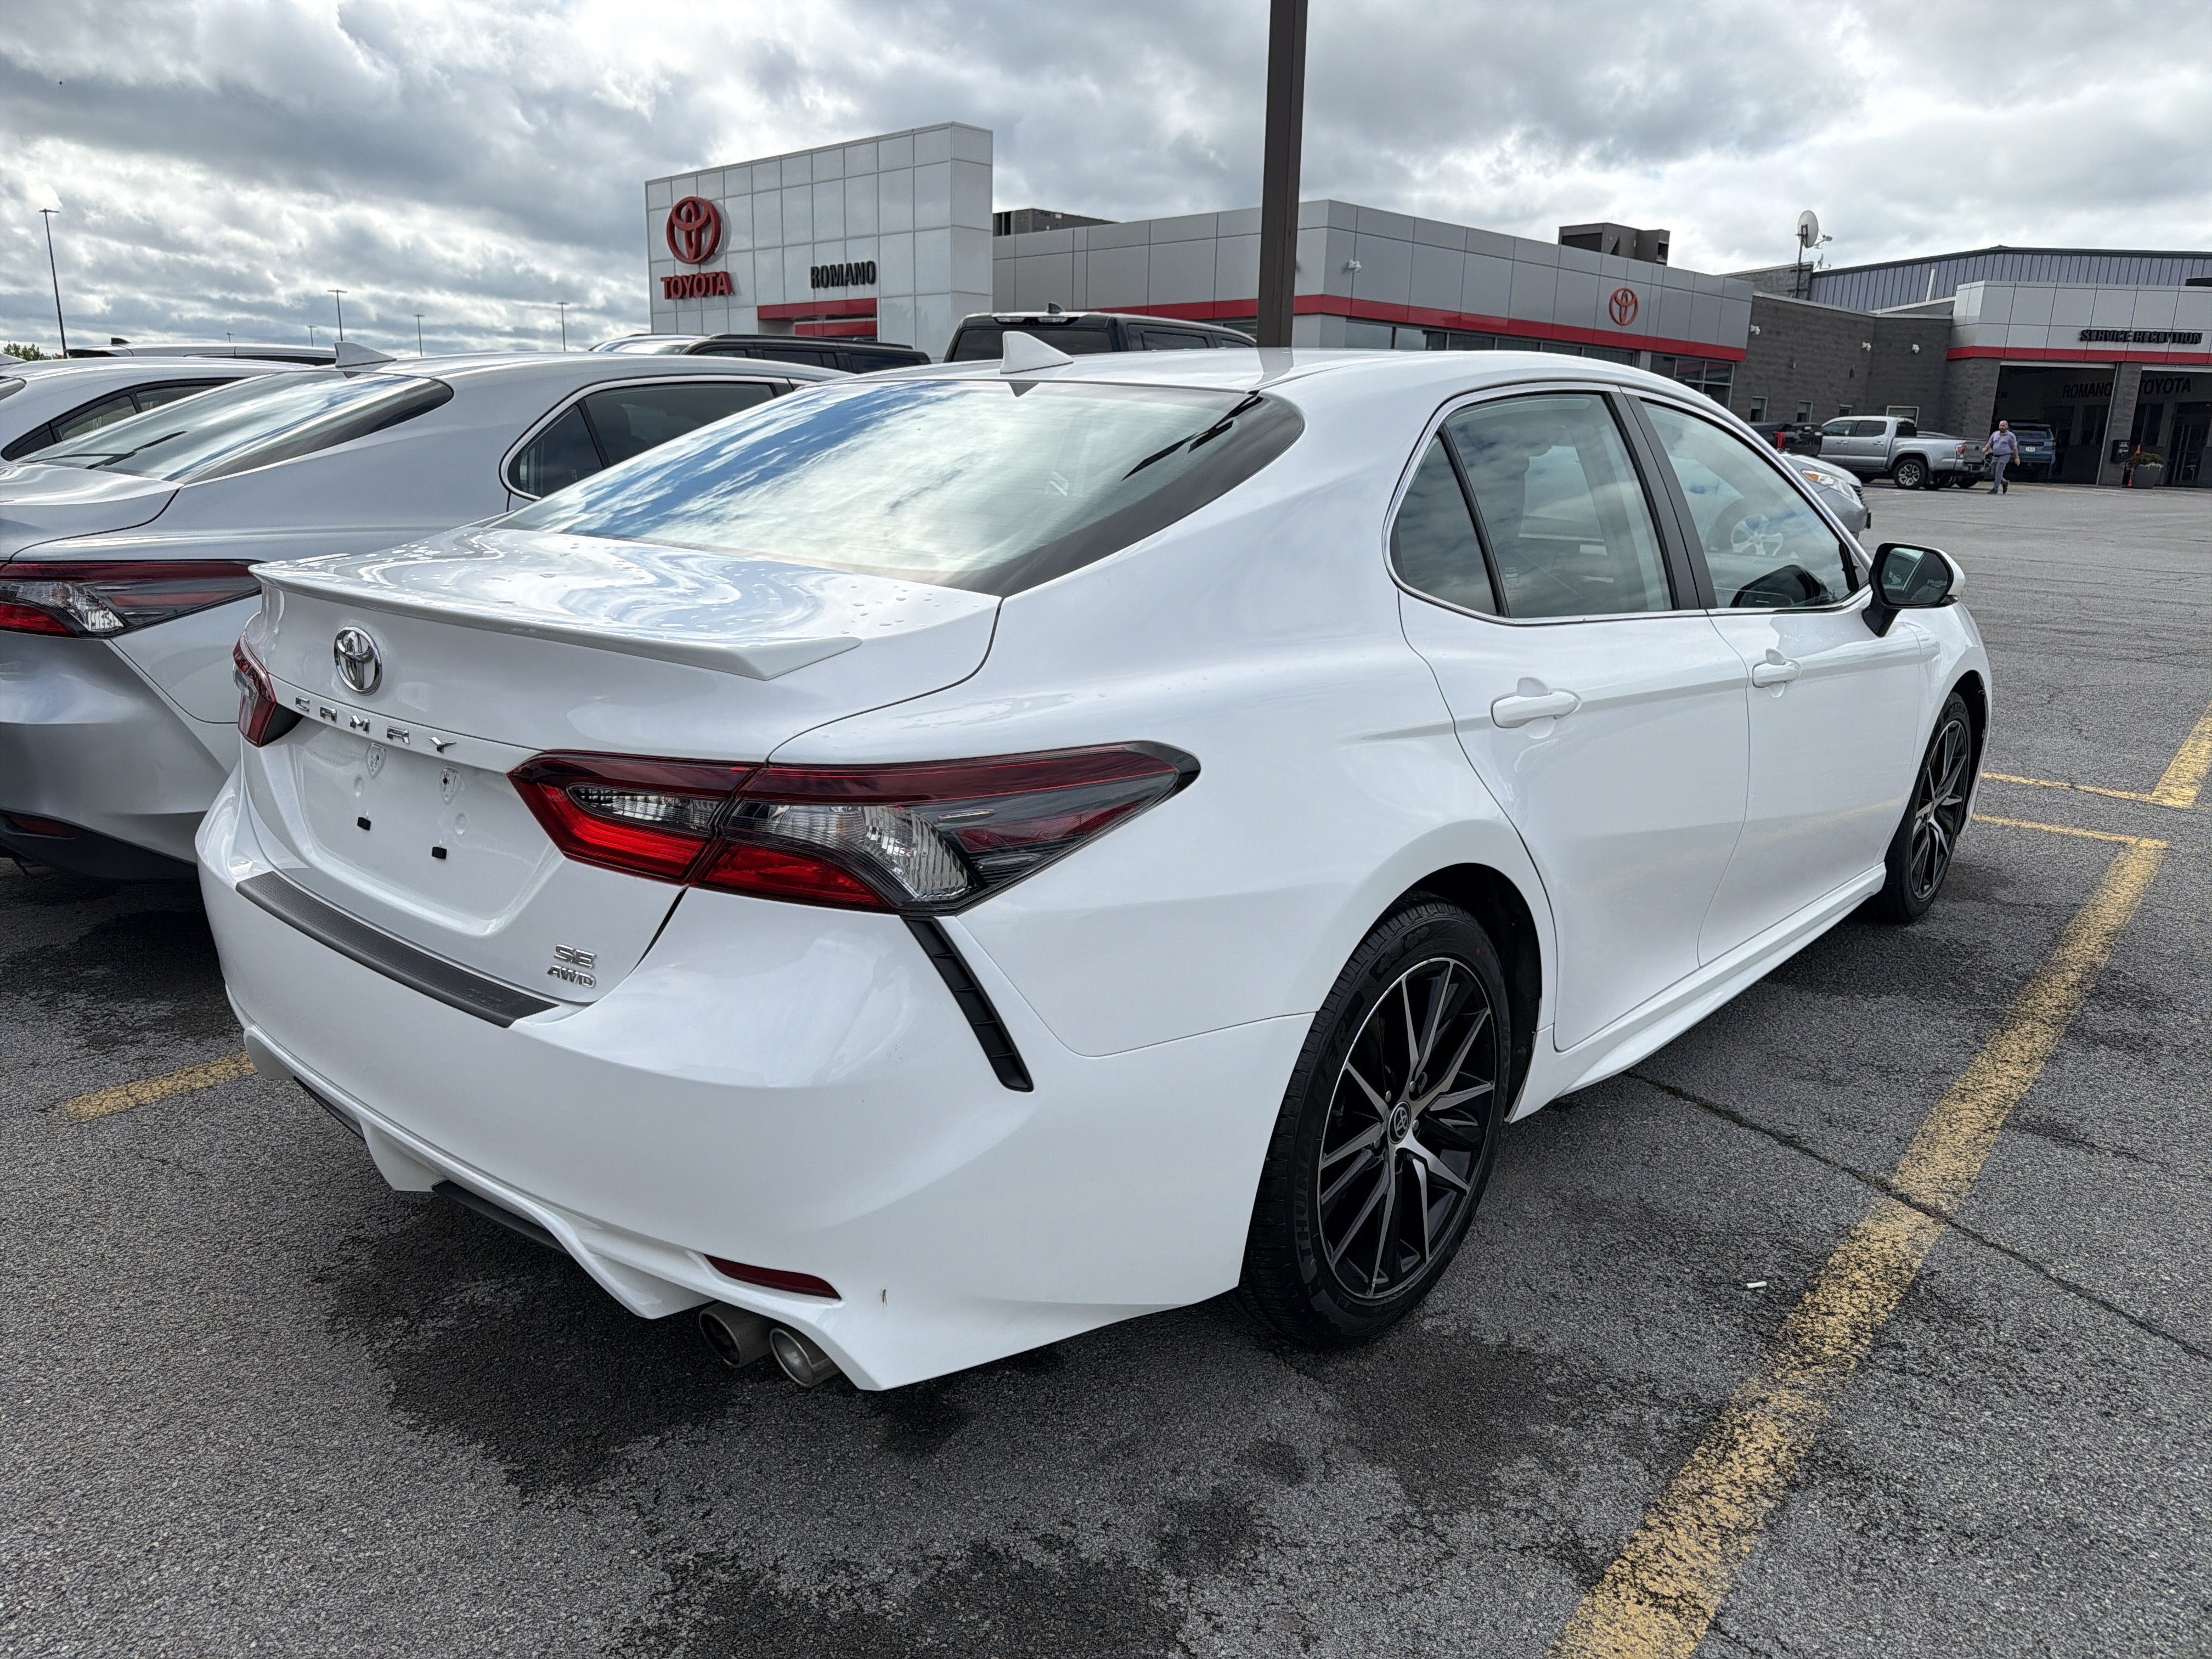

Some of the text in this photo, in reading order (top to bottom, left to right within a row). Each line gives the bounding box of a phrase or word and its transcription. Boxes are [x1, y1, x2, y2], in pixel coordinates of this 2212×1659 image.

[661, 271, 733, 300] TOYOTA
[810, 261, 876, 289] ROMANO
[2080, 330, 2203, 344] SERVICE RECEPTION
[2062, 382, 2113, 399] ROMANO
[295, 696, 456, 754] CAMRY
[554, 944, 597, 969] SE
[547, 964, 597, 988] AWD
